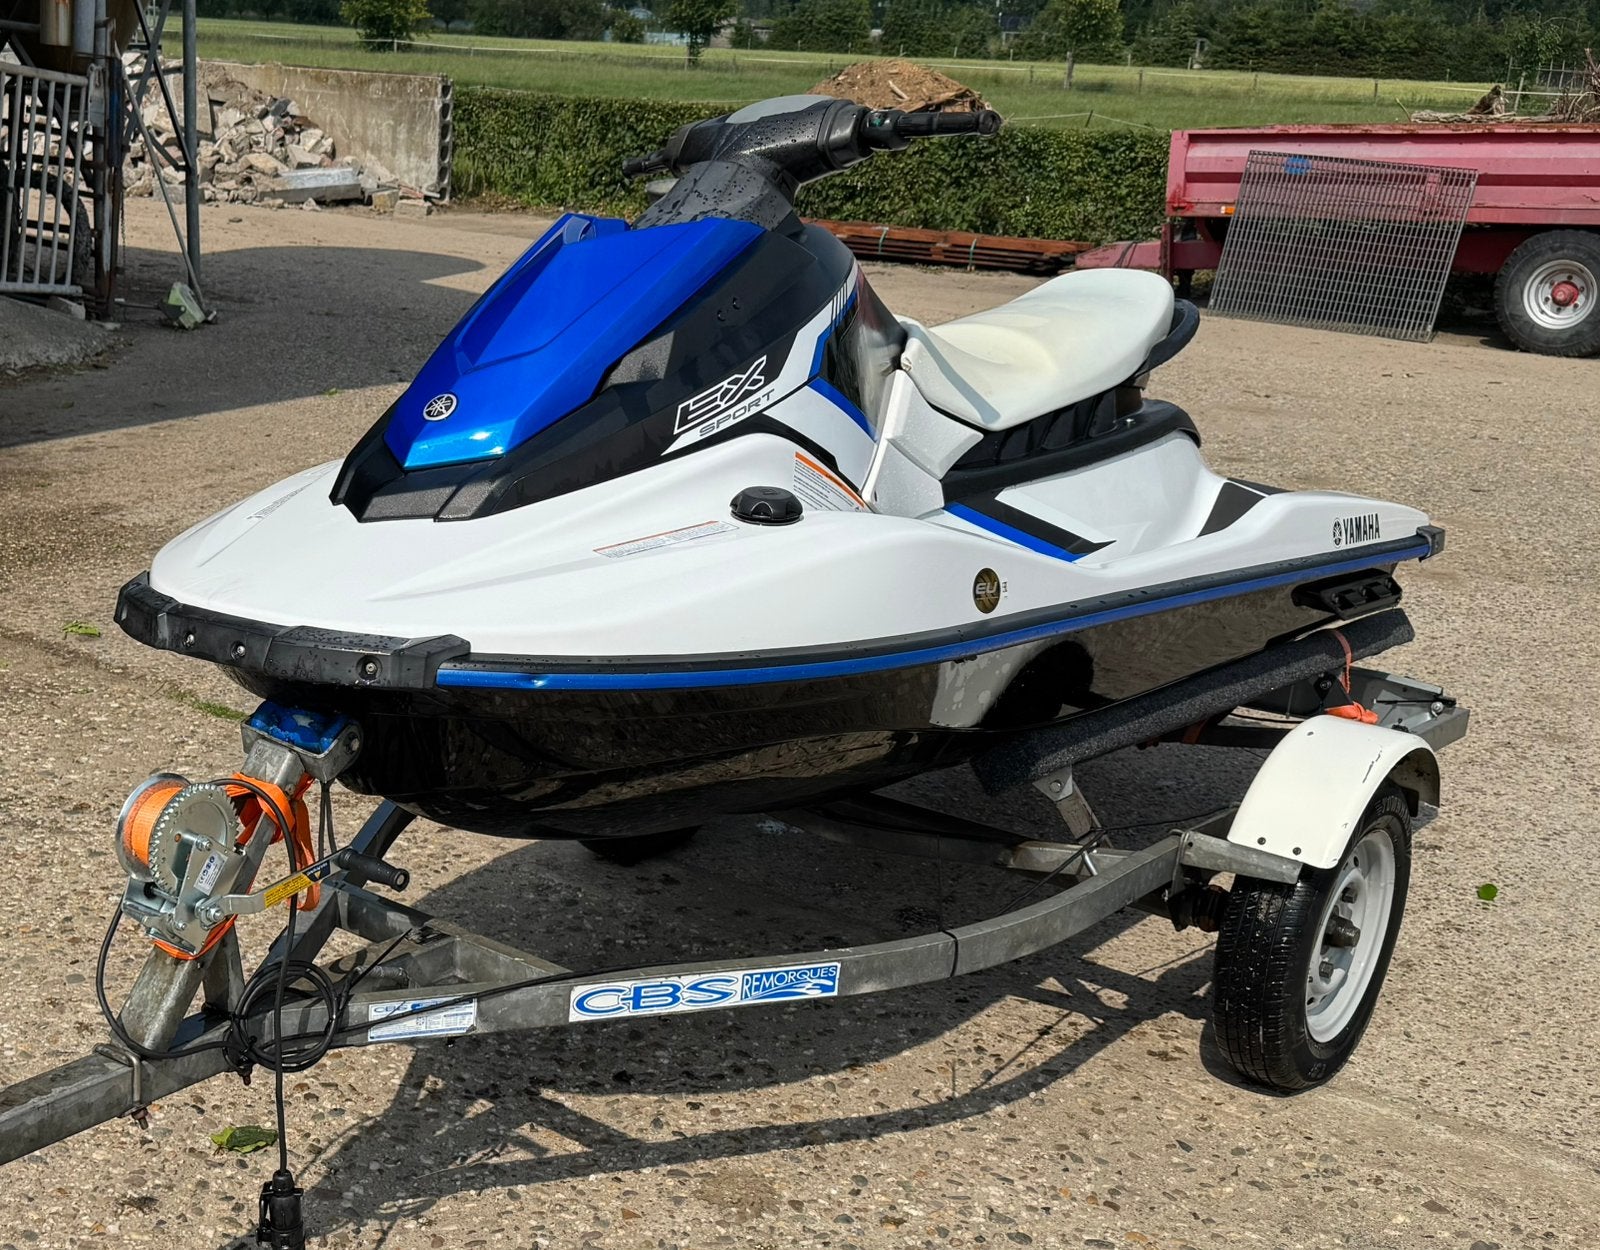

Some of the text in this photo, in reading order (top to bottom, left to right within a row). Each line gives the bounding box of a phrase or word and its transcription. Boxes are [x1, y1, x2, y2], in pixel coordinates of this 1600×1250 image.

[673, 355, 767, 435] EX
[699, 388, 775, 437] SPORT
[1342, 513, 1381, 545] YAMAHA
[573, 966, 837, 1014] CBS REMORQUES
